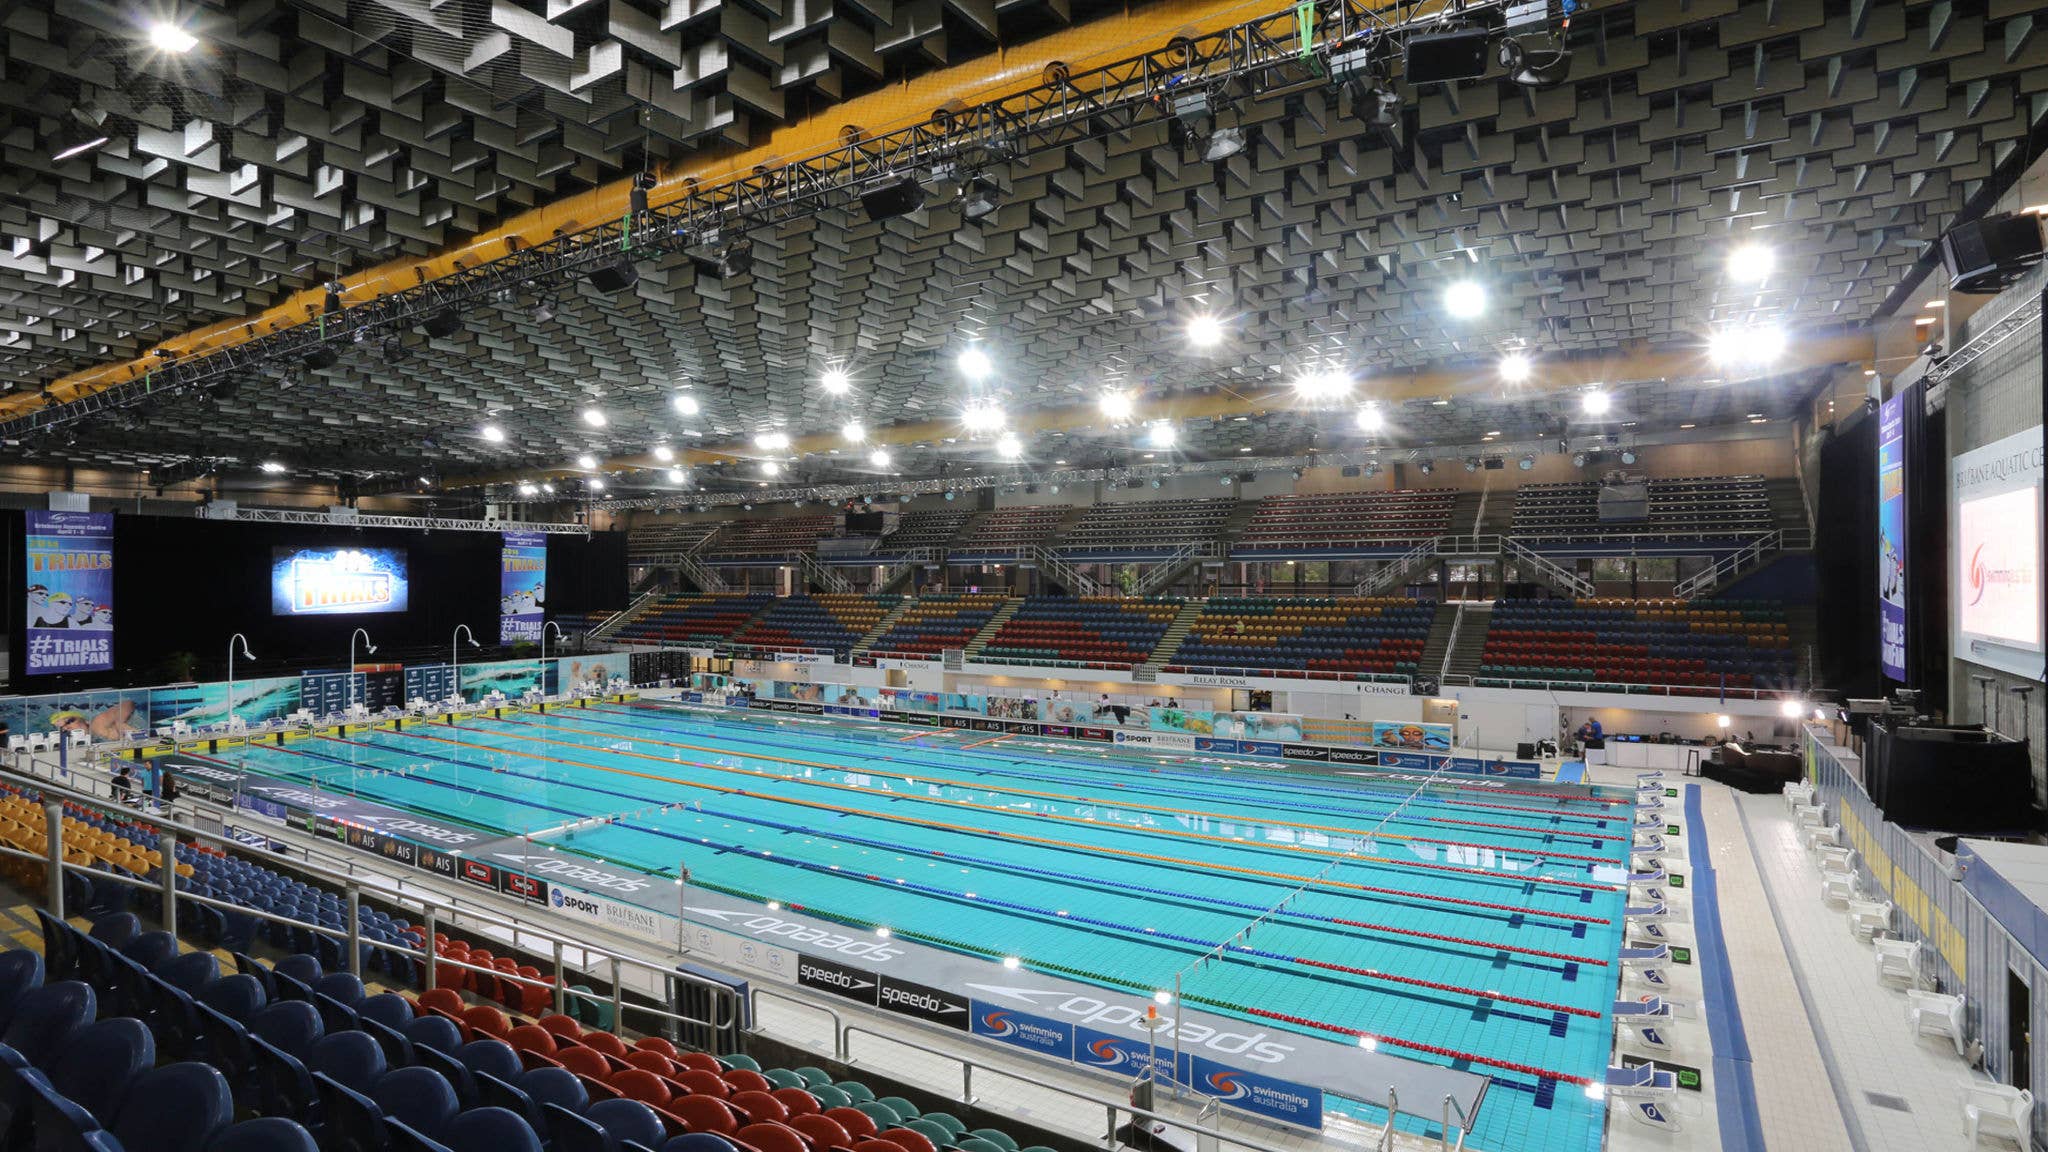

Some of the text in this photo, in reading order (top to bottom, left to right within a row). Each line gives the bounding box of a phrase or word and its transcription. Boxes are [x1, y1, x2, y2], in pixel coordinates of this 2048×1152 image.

[1991, 450, 2030, 481] AQUATIC
[30, 552, 112, 571] TRIALS
[501, 617, 542, 632] #TRIALS
[30, 634, 109, 654] #TRIALS
[29, 651, 110, 668] SWIMFAN
[1193, 676, 1246, 686] RELAY ROOM
[1364, 685, 1407, 696] CHANGE
[954, 719, 966, 728] AIS
[987, 723, 999, 731] AIS
[1021, 725, 1034, 734] AIS
[1126, 735, 1152, 744] SPORT
[1284, 747, 1315, 757] speedo
[1331, 751, 1364, 760] speedo
[362, 834, 375, 848] AIS
[396, 845, 411, 860] AIS
[435, 857, 451, 872] AIS
[534, 860, 651, 892] speedo
[564, 895, 599, 915] SPORT
[743, 916, 905, 963] speedo
[800, 963, 851, 988] speedo
[1650, 972, 1657, 982] 2
[881, 986, 940, 1012] speedo
[1019, 1022, 1063, 1042] swimming
[1058, 996, 1296, 1063] speedo
[1649, 1032, 1655, 1041] 1
[1019, 1032, 1055, 1047] australia
[1130, 1051, 1174, 1068] swimmin
[1252, 1095, 1298, 1113] australia
[1253, 1085, 1309, 1108] swimming
